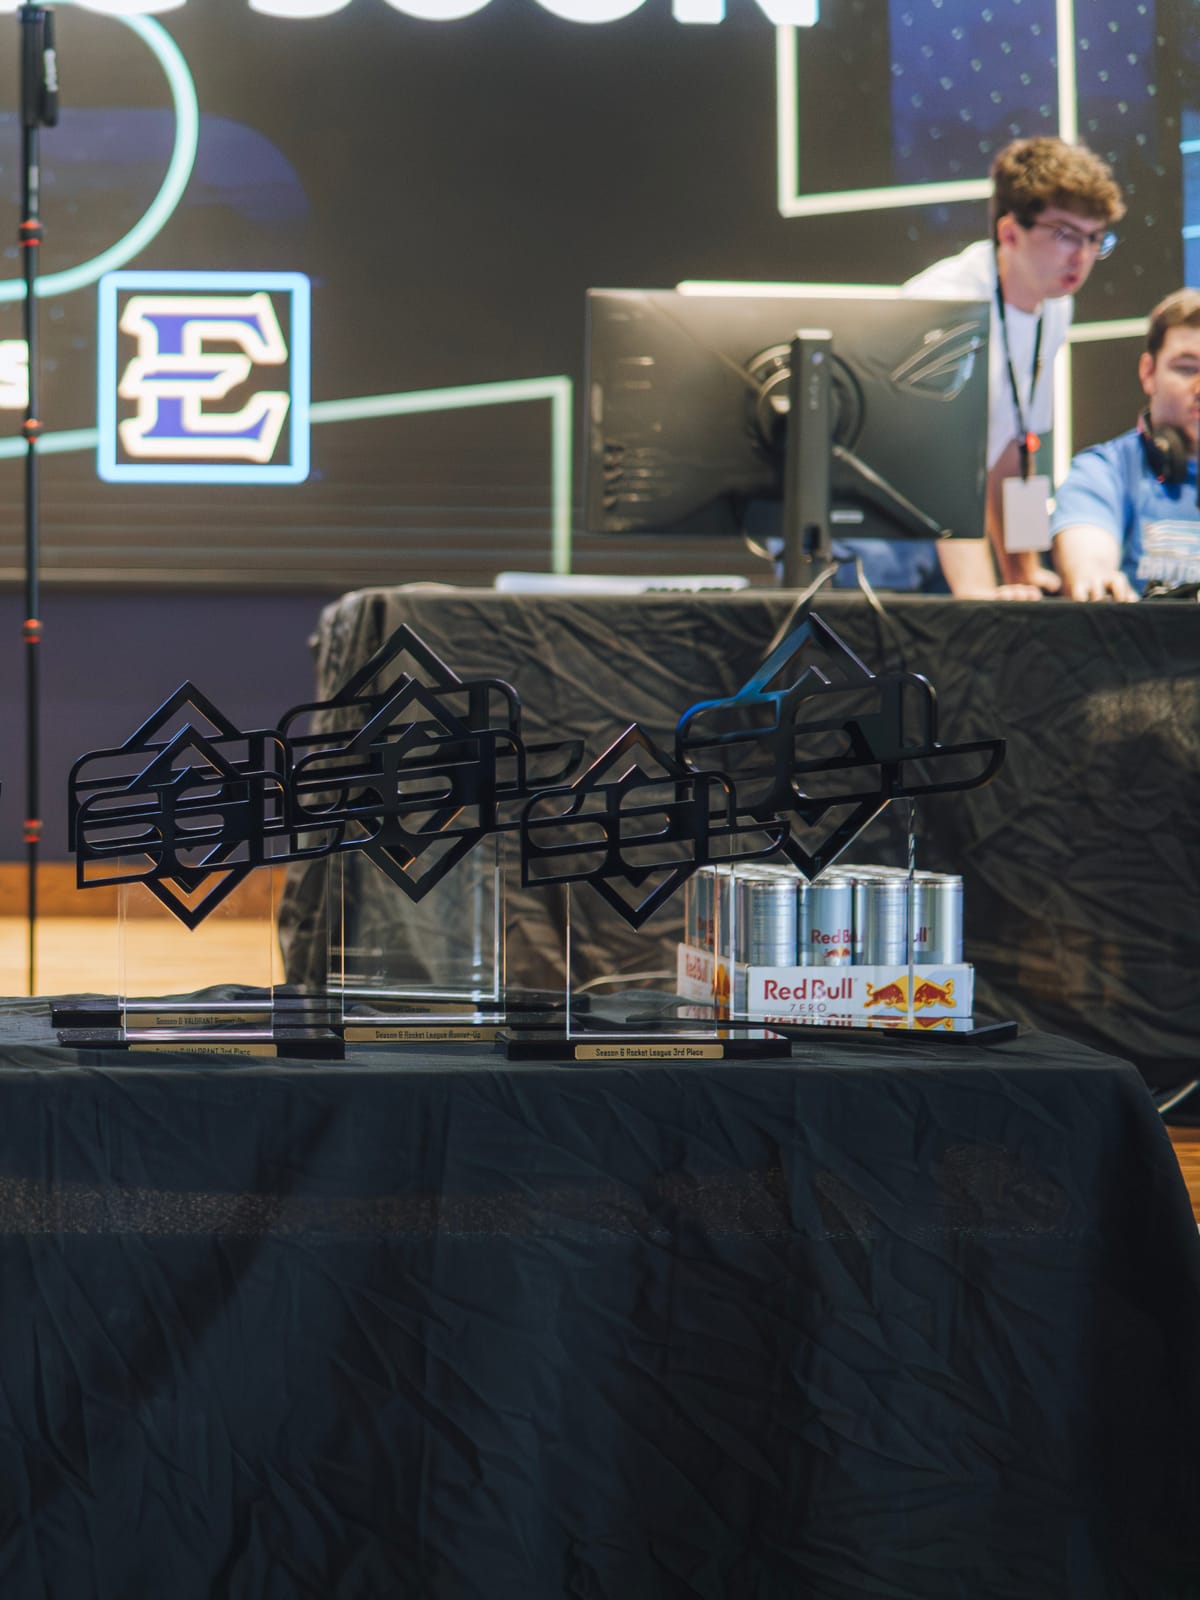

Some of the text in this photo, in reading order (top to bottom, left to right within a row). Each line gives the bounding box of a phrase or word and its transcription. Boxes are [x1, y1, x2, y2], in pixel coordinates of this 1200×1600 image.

[811, 928, 841, 944] Red
[764, 977, 852, 1000] Red Bull
[375, 1030, 397, 1039] Season
[404, 1030, 425, 1039] Rocket
[426, 1030, 447, 1040] League
[595, 1047, 704, 1058] Season 6 Rocket League 3rd Place
